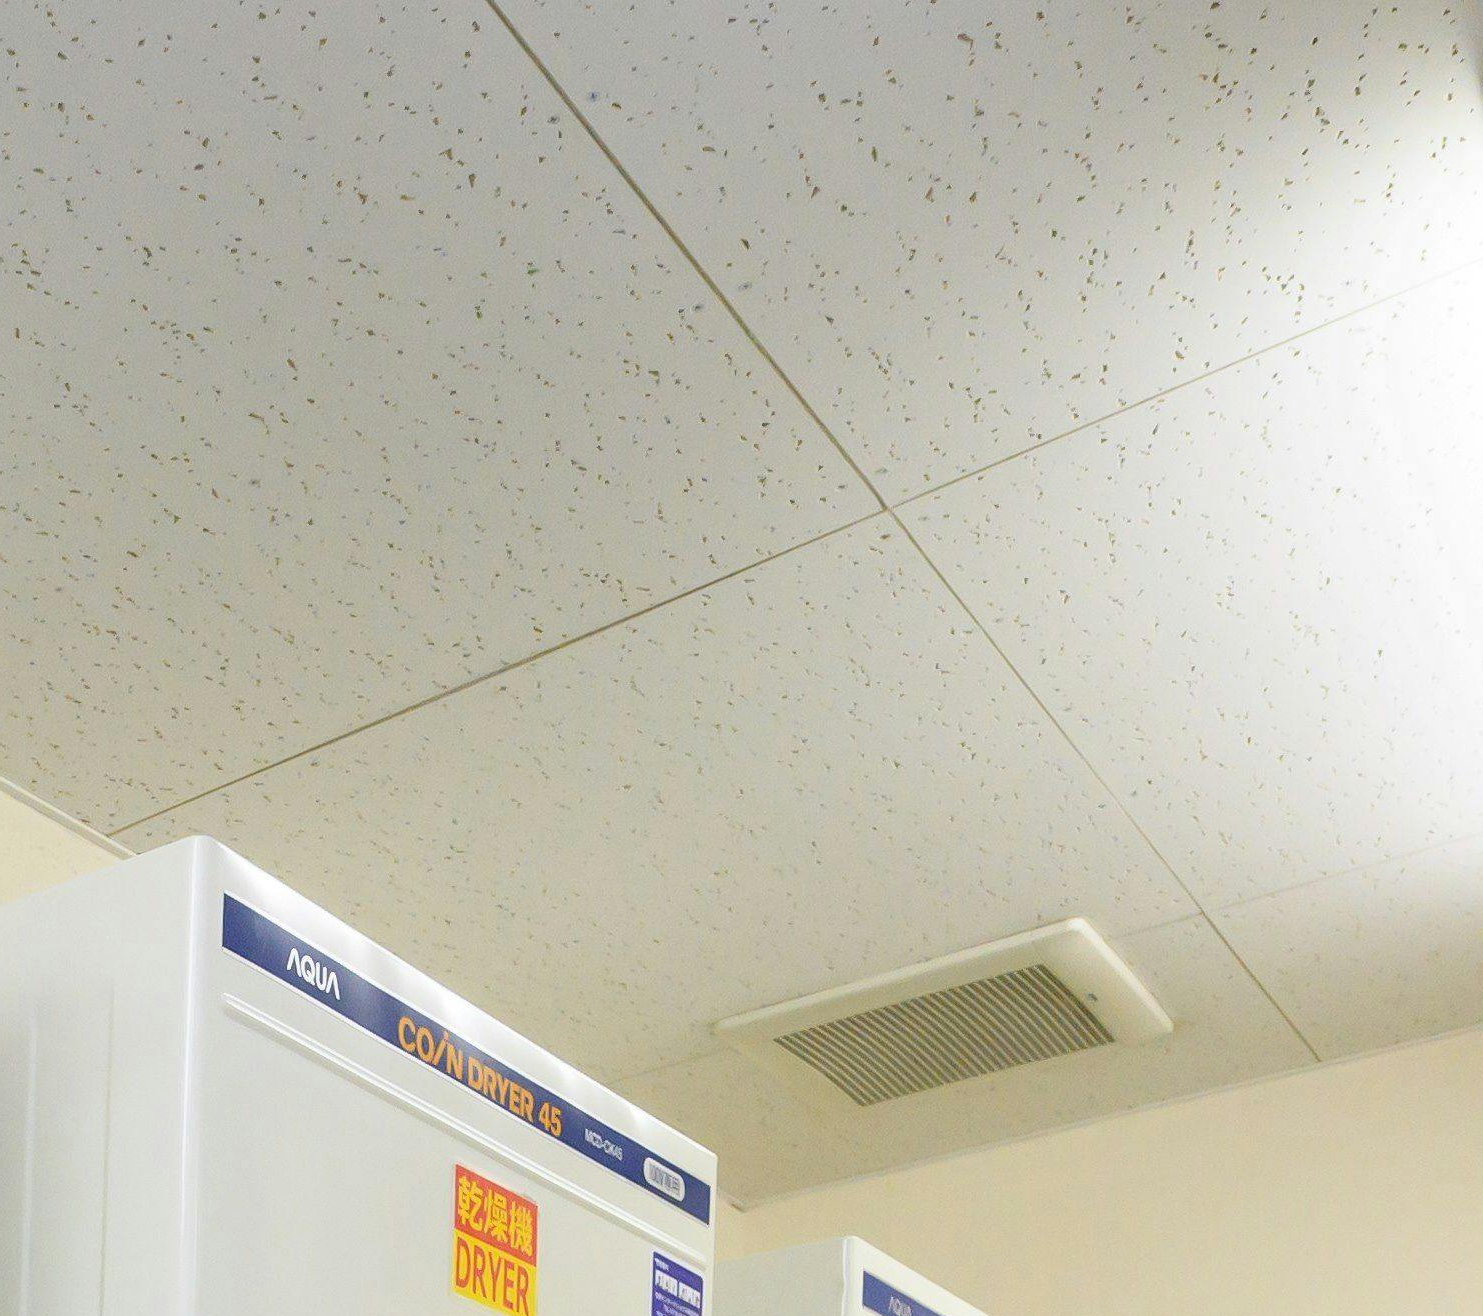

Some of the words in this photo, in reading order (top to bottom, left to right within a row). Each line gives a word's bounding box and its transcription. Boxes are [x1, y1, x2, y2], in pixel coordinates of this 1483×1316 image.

[287, 947, 340, 1000] AQUA
[467, 1057, 534, 1121] DRYER
[538, 1102, 561, 1137] 45
[455, 1175, 532, 1256] 乾燥機
